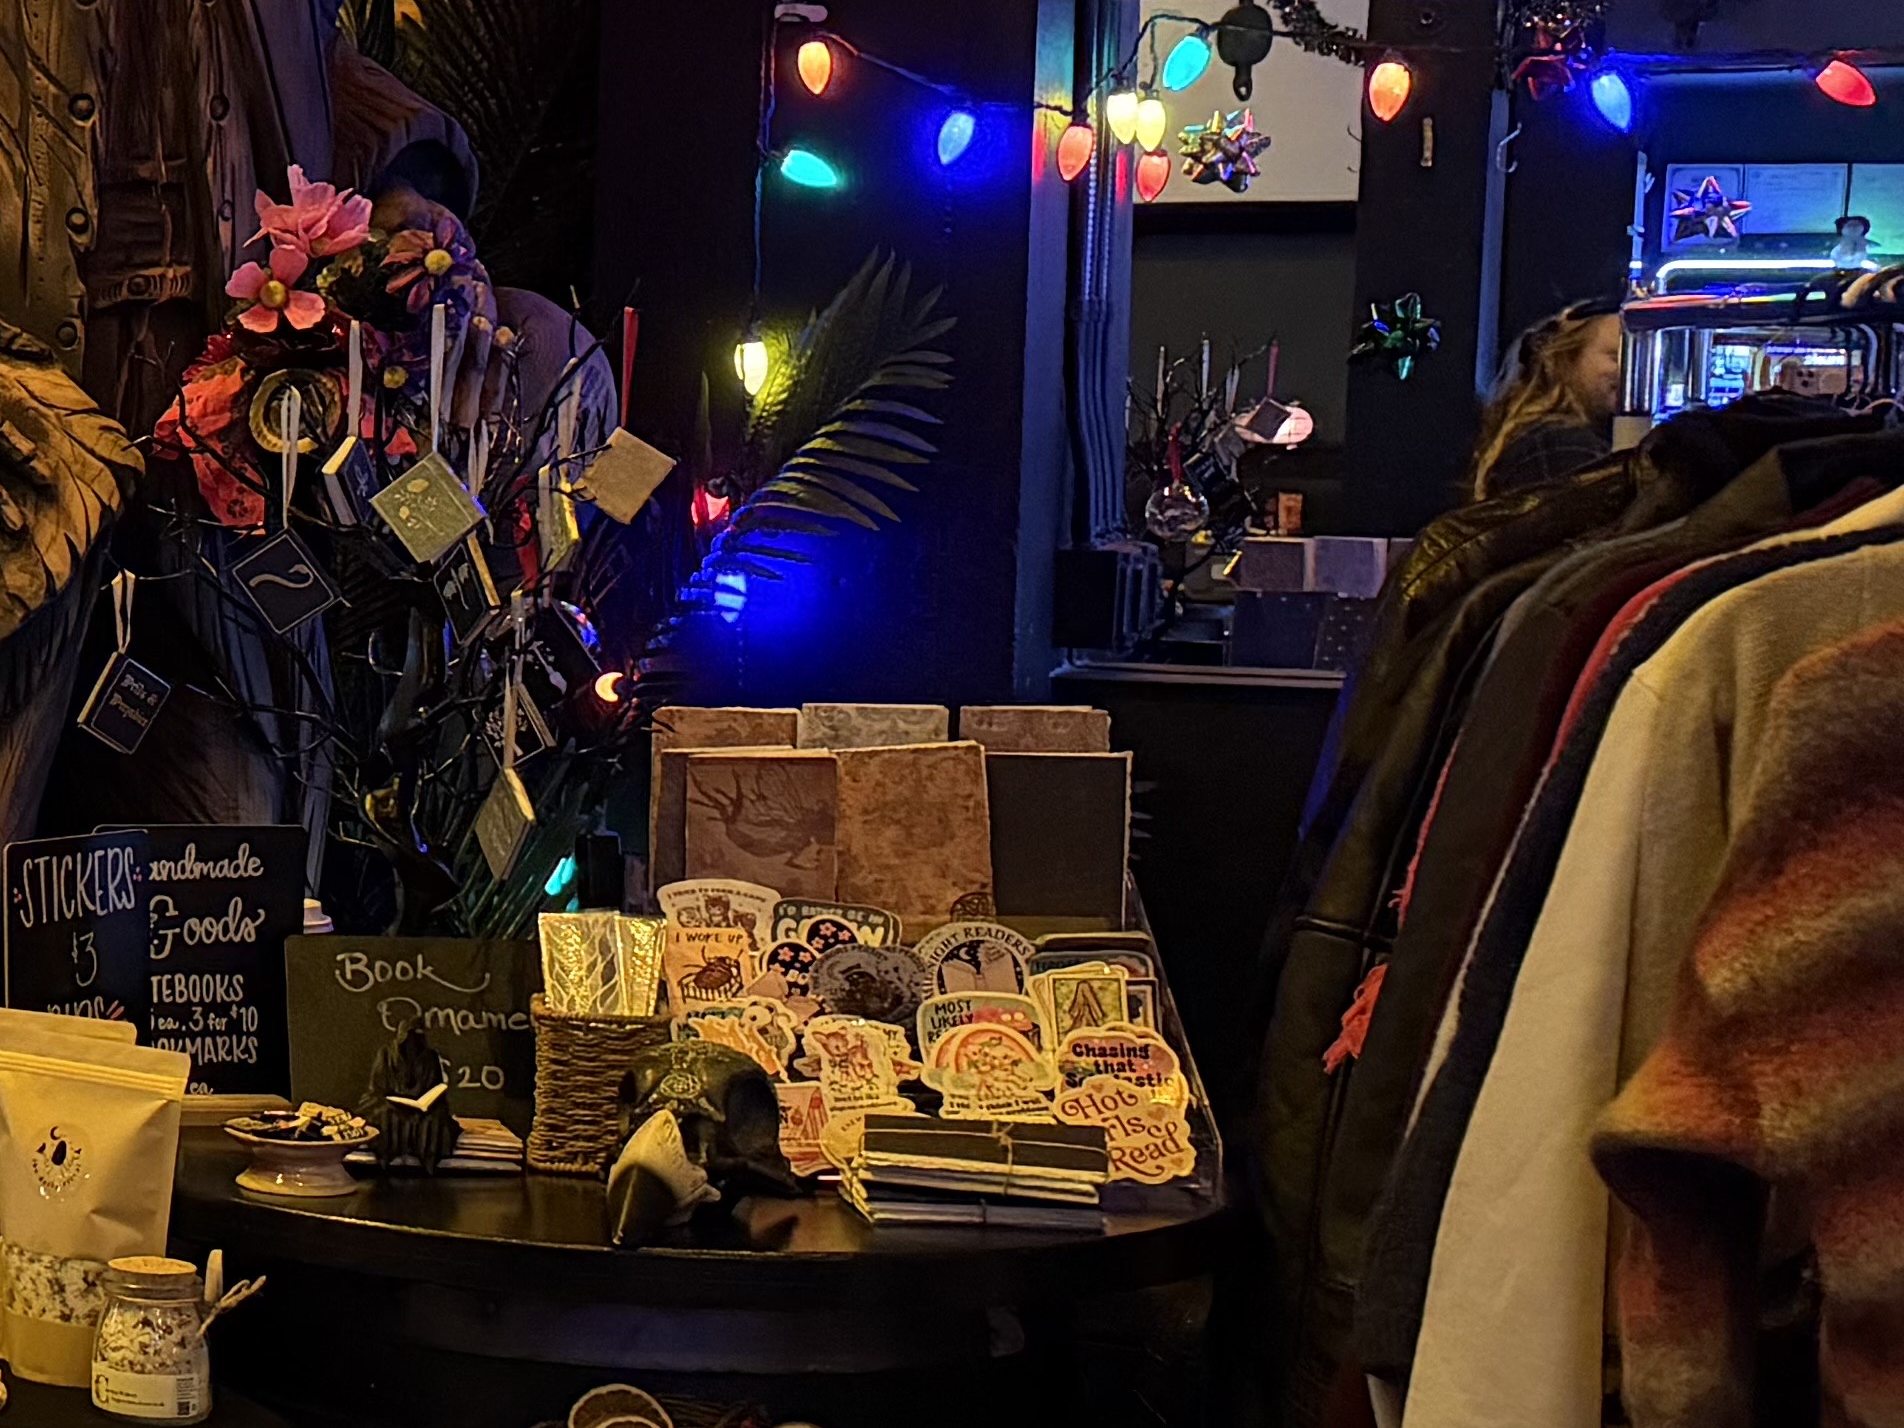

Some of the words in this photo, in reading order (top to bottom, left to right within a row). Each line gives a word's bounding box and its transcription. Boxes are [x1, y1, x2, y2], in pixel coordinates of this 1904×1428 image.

[20, 846, 136, 929] STICKERS
[149, 894, 266, 960] Goods
[675, 933, 681, 943] I
[685, 932, 722, 944] WOKE
[727, 933, 743, 945] UP
[963, 926, 1031, 956] READERS
[71, 931, 98, 988] $3
[335, 951, 491, 993] Book
[150, 973, 244, 1004] TEBOOKS
[191, 1006, 204, 1032] 3
[207, 1012, 228, 1031] for
[229, 1004, 259, 1032] $10
[930, 1013, 974, 1028] LIKELY
[934, 999, 972, 1014] MOST
[1071, 1042, 1151, 1060] Chasing
[1093, 1058, 1137, 1073] that
[1061, 1087, 1139, 1120] Hot
[1101, 1114, 1146, 1140] rls
[1109, 1134, 1184, 1177] Read
